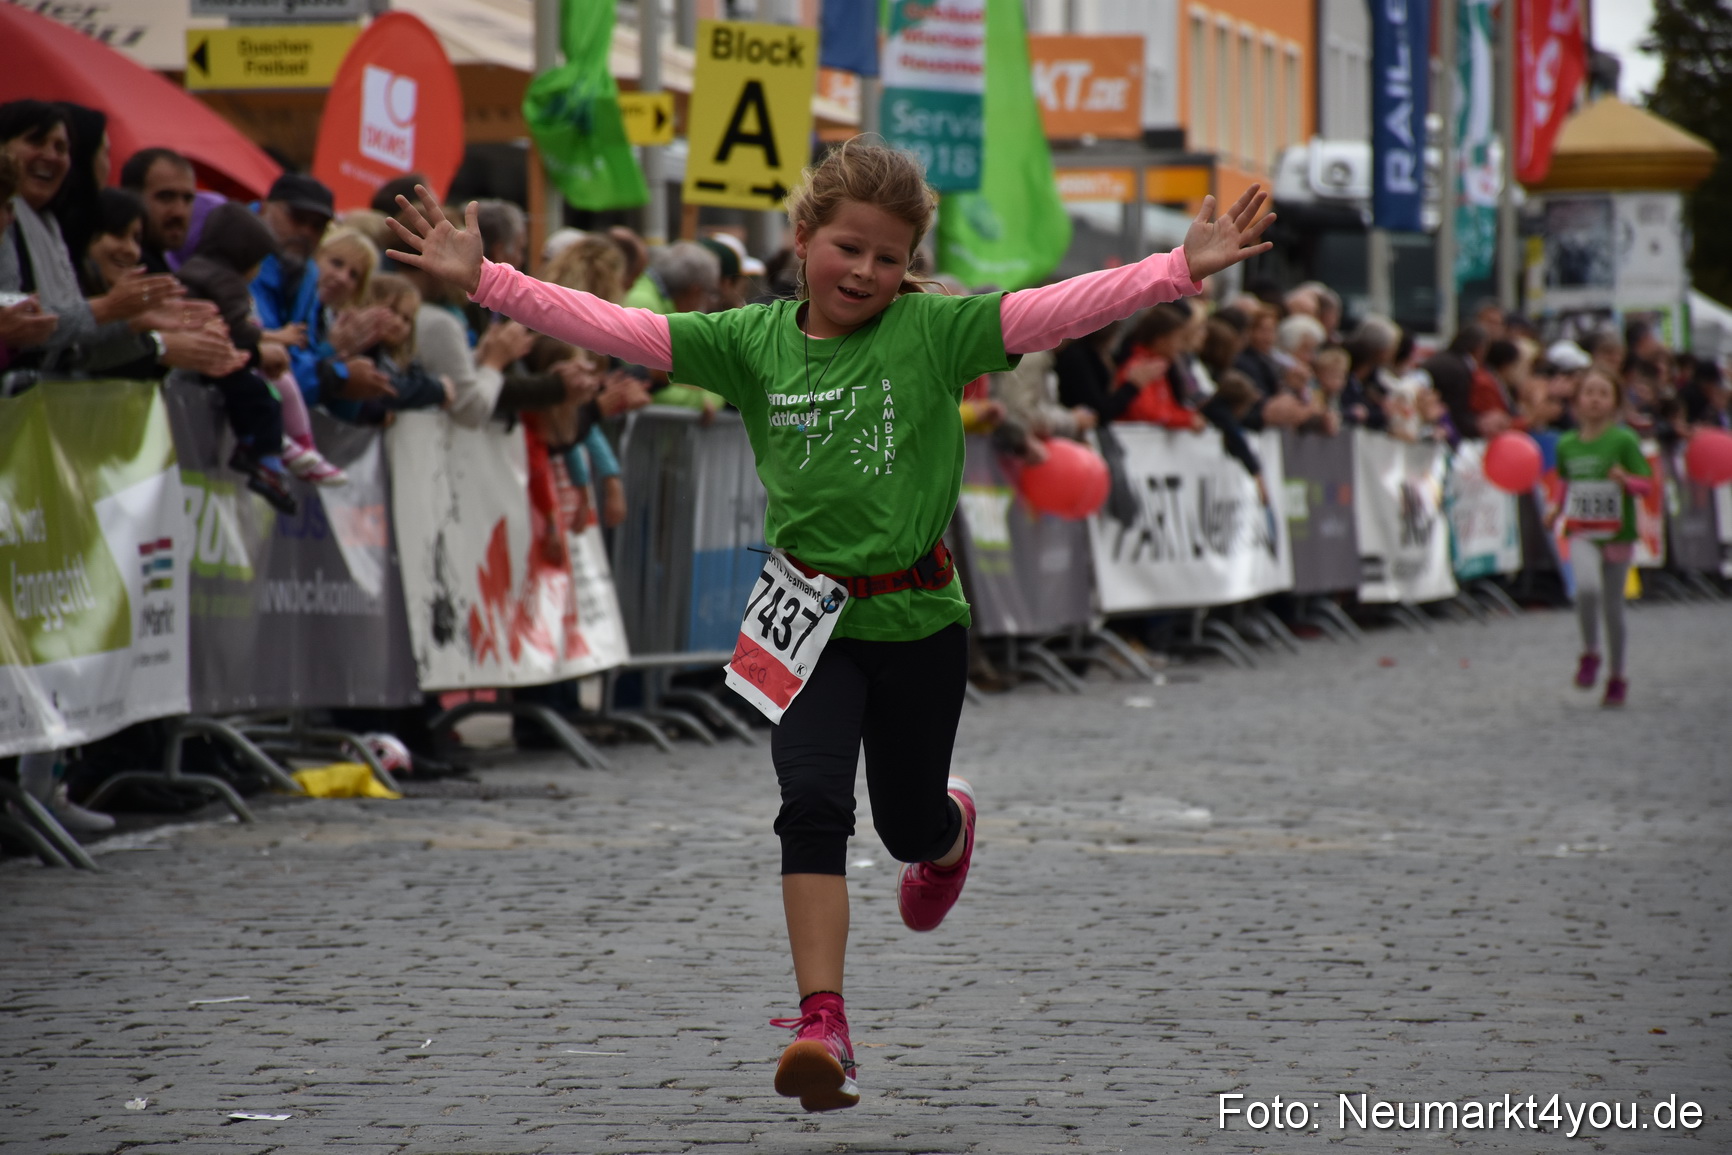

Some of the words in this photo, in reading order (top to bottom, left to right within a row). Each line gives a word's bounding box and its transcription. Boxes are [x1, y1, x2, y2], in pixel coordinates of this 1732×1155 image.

[710, 26, 805, 68] Block
[713, 79, 781, 168] A
[892, 99, 983, 138] Servi
[881, 378, 896, 475] BAMBINI
[744, 570, 821, 661] 7437
